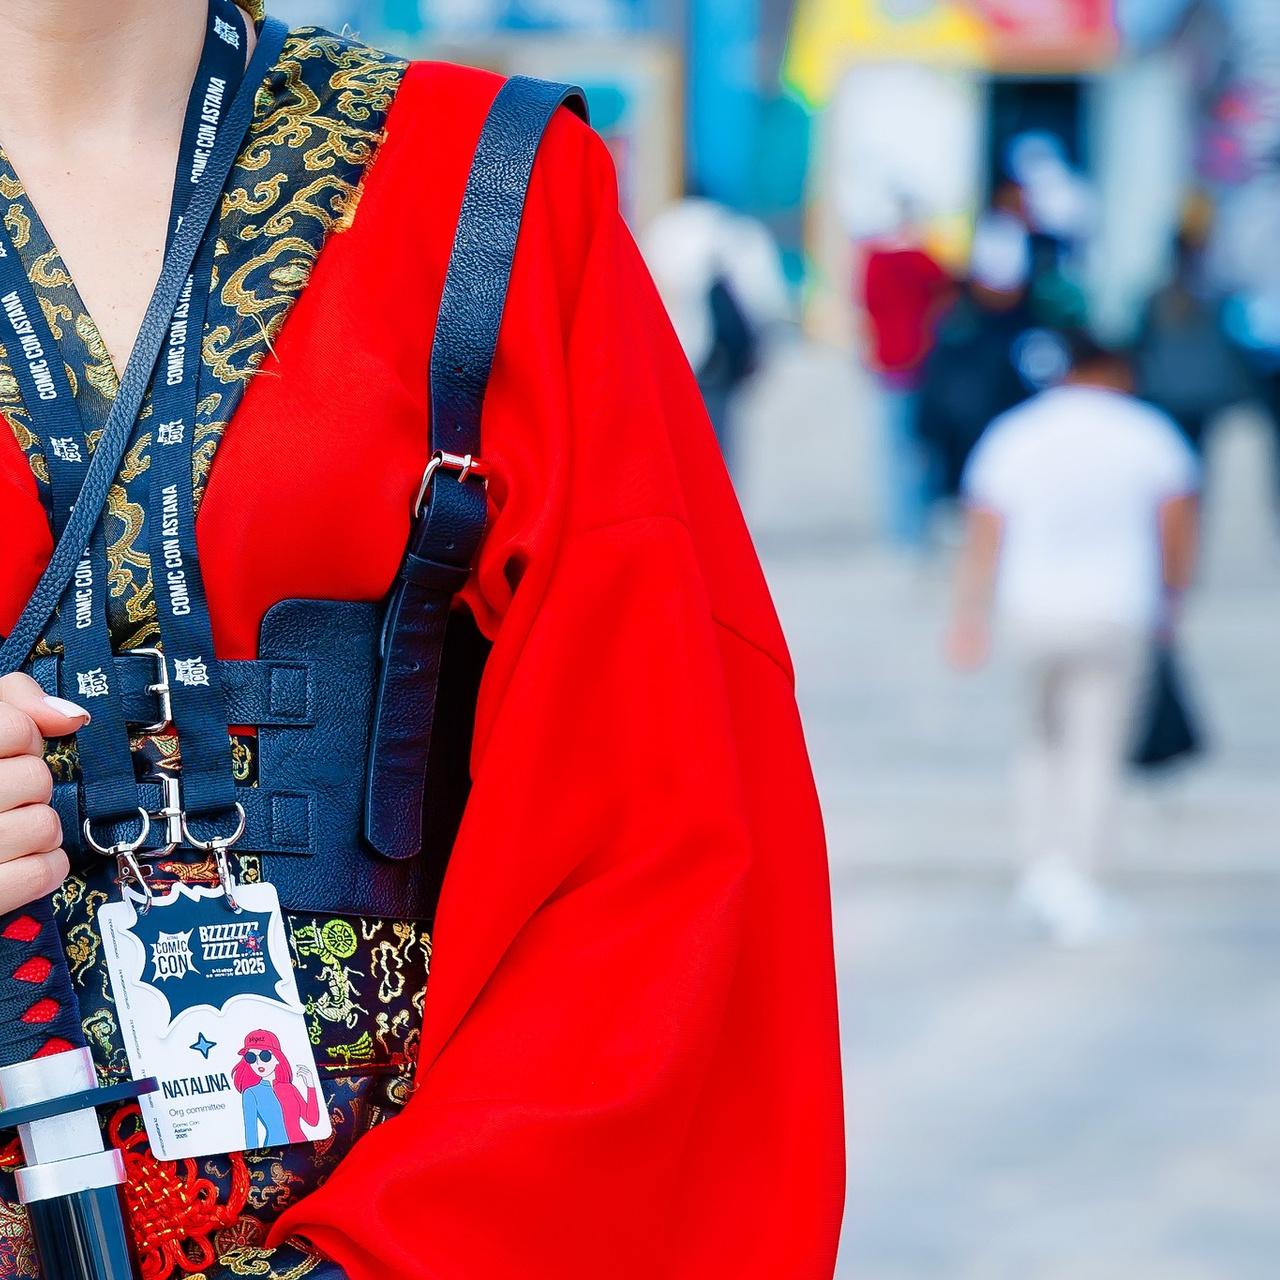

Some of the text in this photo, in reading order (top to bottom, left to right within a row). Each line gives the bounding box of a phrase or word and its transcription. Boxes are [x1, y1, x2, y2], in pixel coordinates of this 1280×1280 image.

[201, 76, 226, 125] ASTANA
[196, 124, 217, 148] CON
[1, 290, 34, 335] ASTANA
[169, 320, 187, 346] CON
[19, 334, 44, 360] CON
[162, 484, 179, 536] ASTANA
[162, 539, 183, 569] CON
[75, 560, 92, 588] CON
[159, 954, 188, 975] CON
[233, 958, 266, 976] 2025
[161, 1072, 231, 1099] NATALINA
[169, 1103, 226, 1118] Org committee
